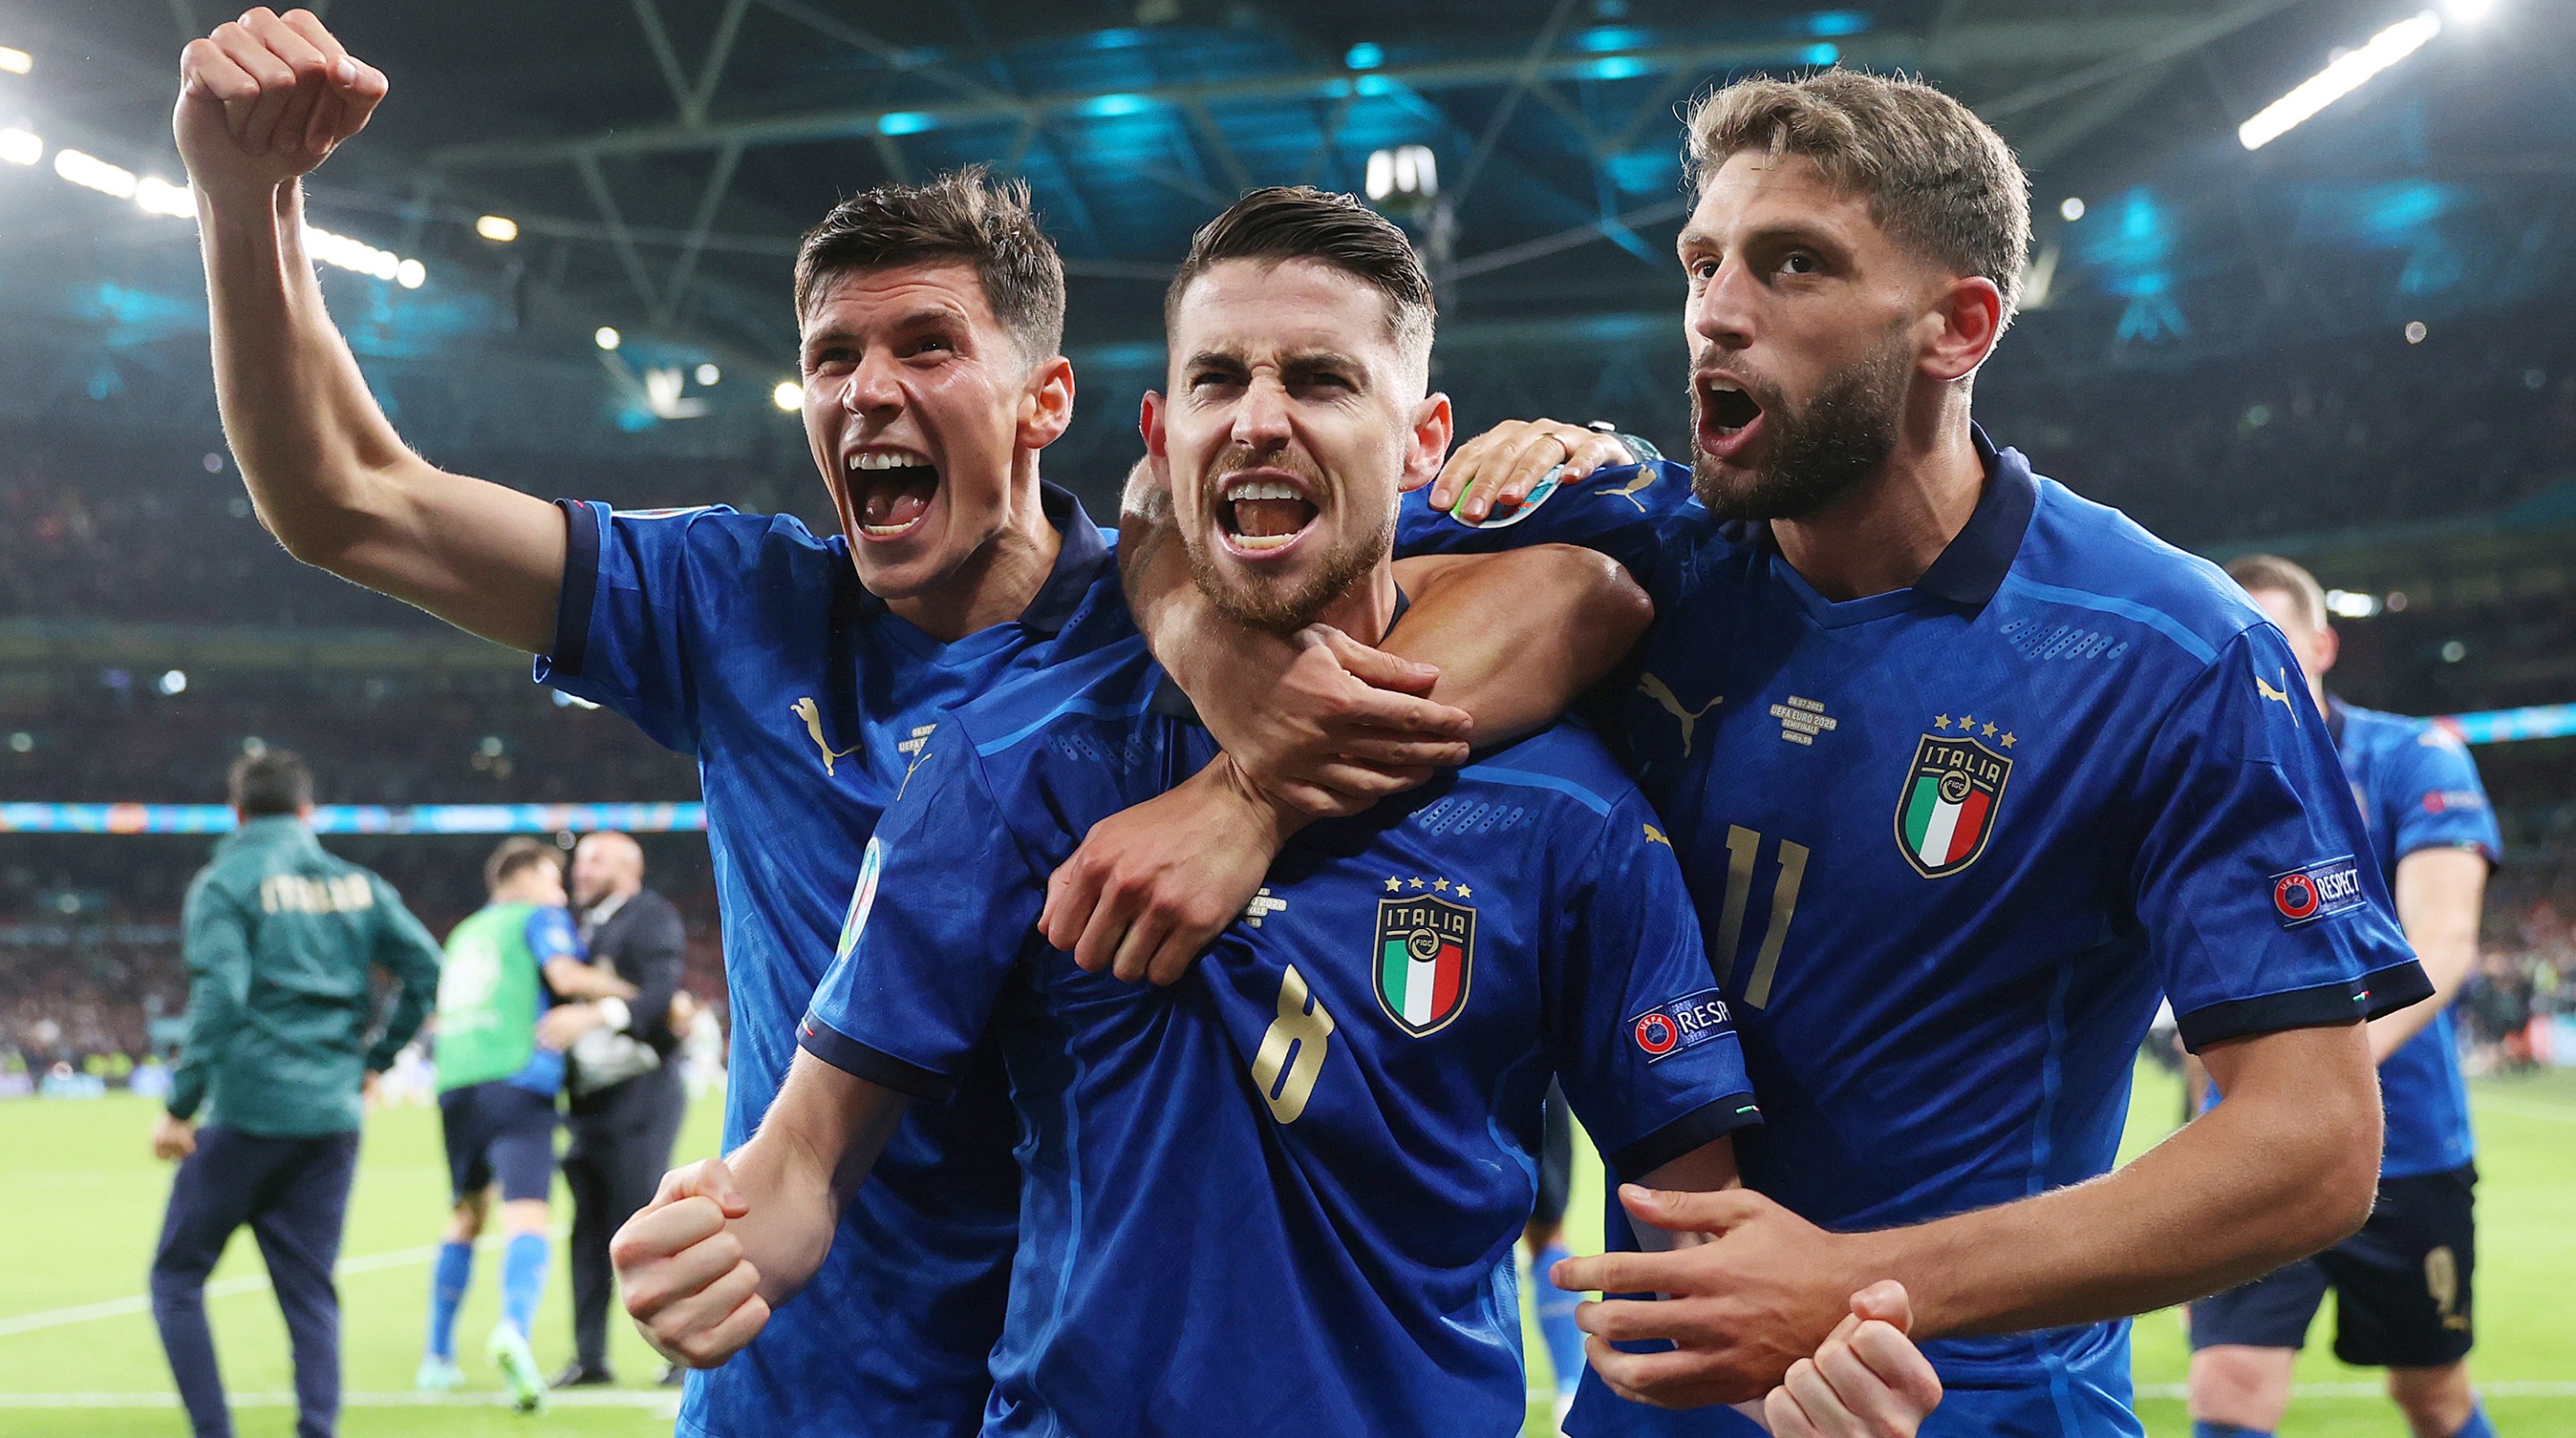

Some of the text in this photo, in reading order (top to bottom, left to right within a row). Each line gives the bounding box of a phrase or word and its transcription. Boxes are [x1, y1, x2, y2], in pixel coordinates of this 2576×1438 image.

[1771, 705, 1836, 729] UEFA EURO 2020
[1783, 718, 1819, 733] SEMIFINALE
[898, 739, 920, 753] UEFA
[1924, 746, 2001, 783] ITALIA
[1947, 779, 1965, 791] FIGC
[2279, 868, 2360, 901] UEFA RESPECT
[1259, 899, 1284, 909] 2020
[1715, 824, 1810, 1011] 11
[1386, 908, 1465, 935] ITALIA
[1415, 938, 1433, 947] FIGC
[1639, 1000, 1733, 1034] UEFA RESP
[1251, 962, 1335, 1125] 8
[2423, 1244, 2459, 1315] 9
